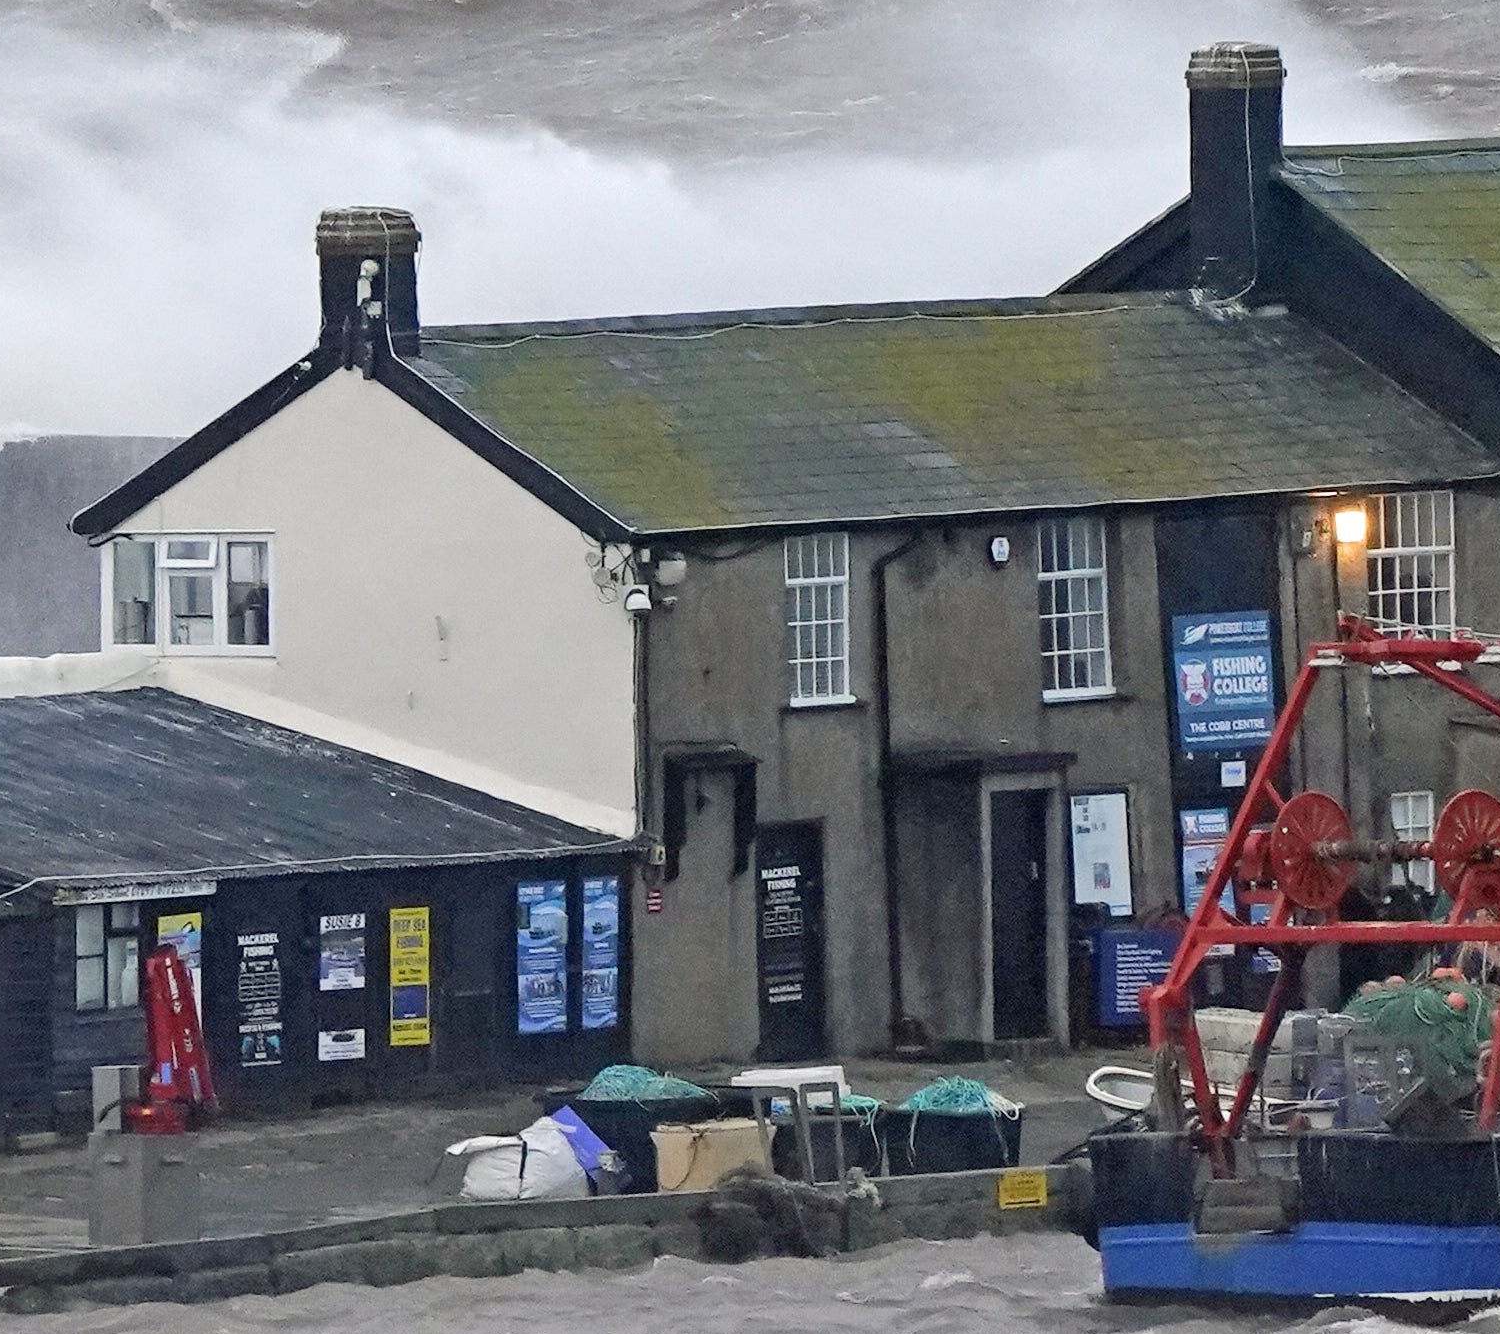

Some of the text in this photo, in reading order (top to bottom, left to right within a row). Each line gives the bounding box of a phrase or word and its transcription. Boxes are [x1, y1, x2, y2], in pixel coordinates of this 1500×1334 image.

[1212, 656, 1266, 677] FISHING
[1212, 675, 1268, 695] COLLEGE
[1190, 718, 1266, 733] THE COBB CENTRE
[761, 866, 801, 880] MACKEREL
[767, 878, 797, 891] FISHING
[325, 915, 362, 929] SUSIE B
[237, 933, 279, 946] MACKEREL
